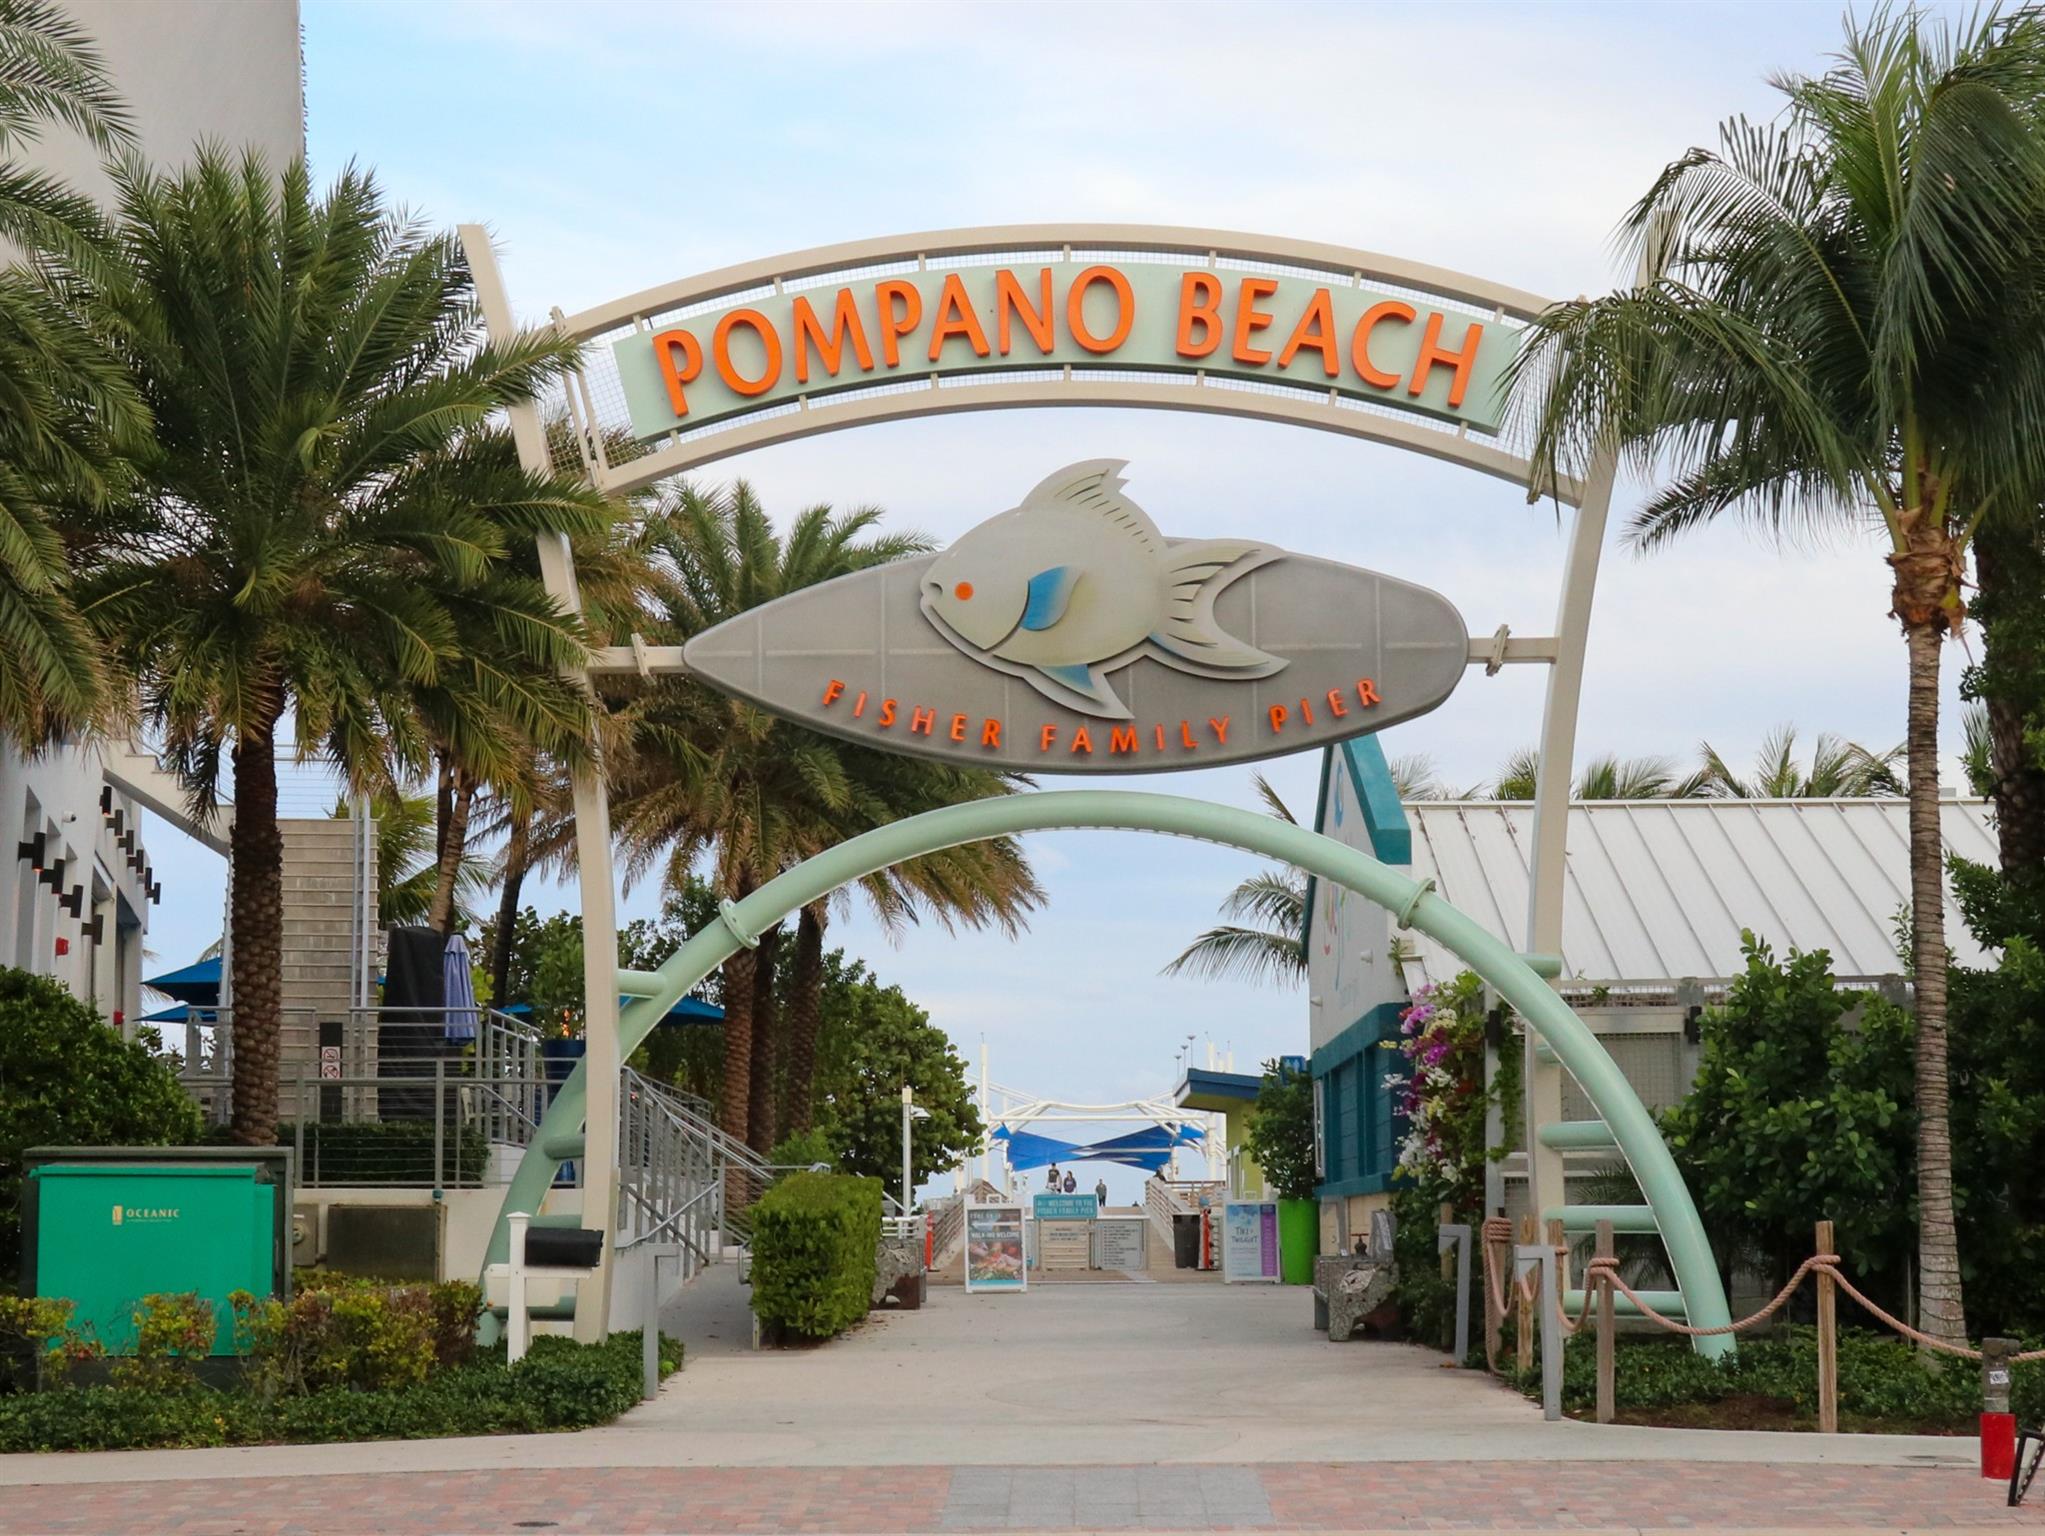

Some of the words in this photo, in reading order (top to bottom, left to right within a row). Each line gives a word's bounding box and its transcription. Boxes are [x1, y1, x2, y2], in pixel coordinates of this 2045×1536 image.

[652, 265, 1136, 418] POMPANO
[1175, 271, 1483, 408] BEACH
[822, 679, 1002, 748] FISHER
[1039, 716, 1231, 754] FAMILY
[1268, 677, 1382, 735] PIER
[126, 1208, 180, 1218] OCEANIC
